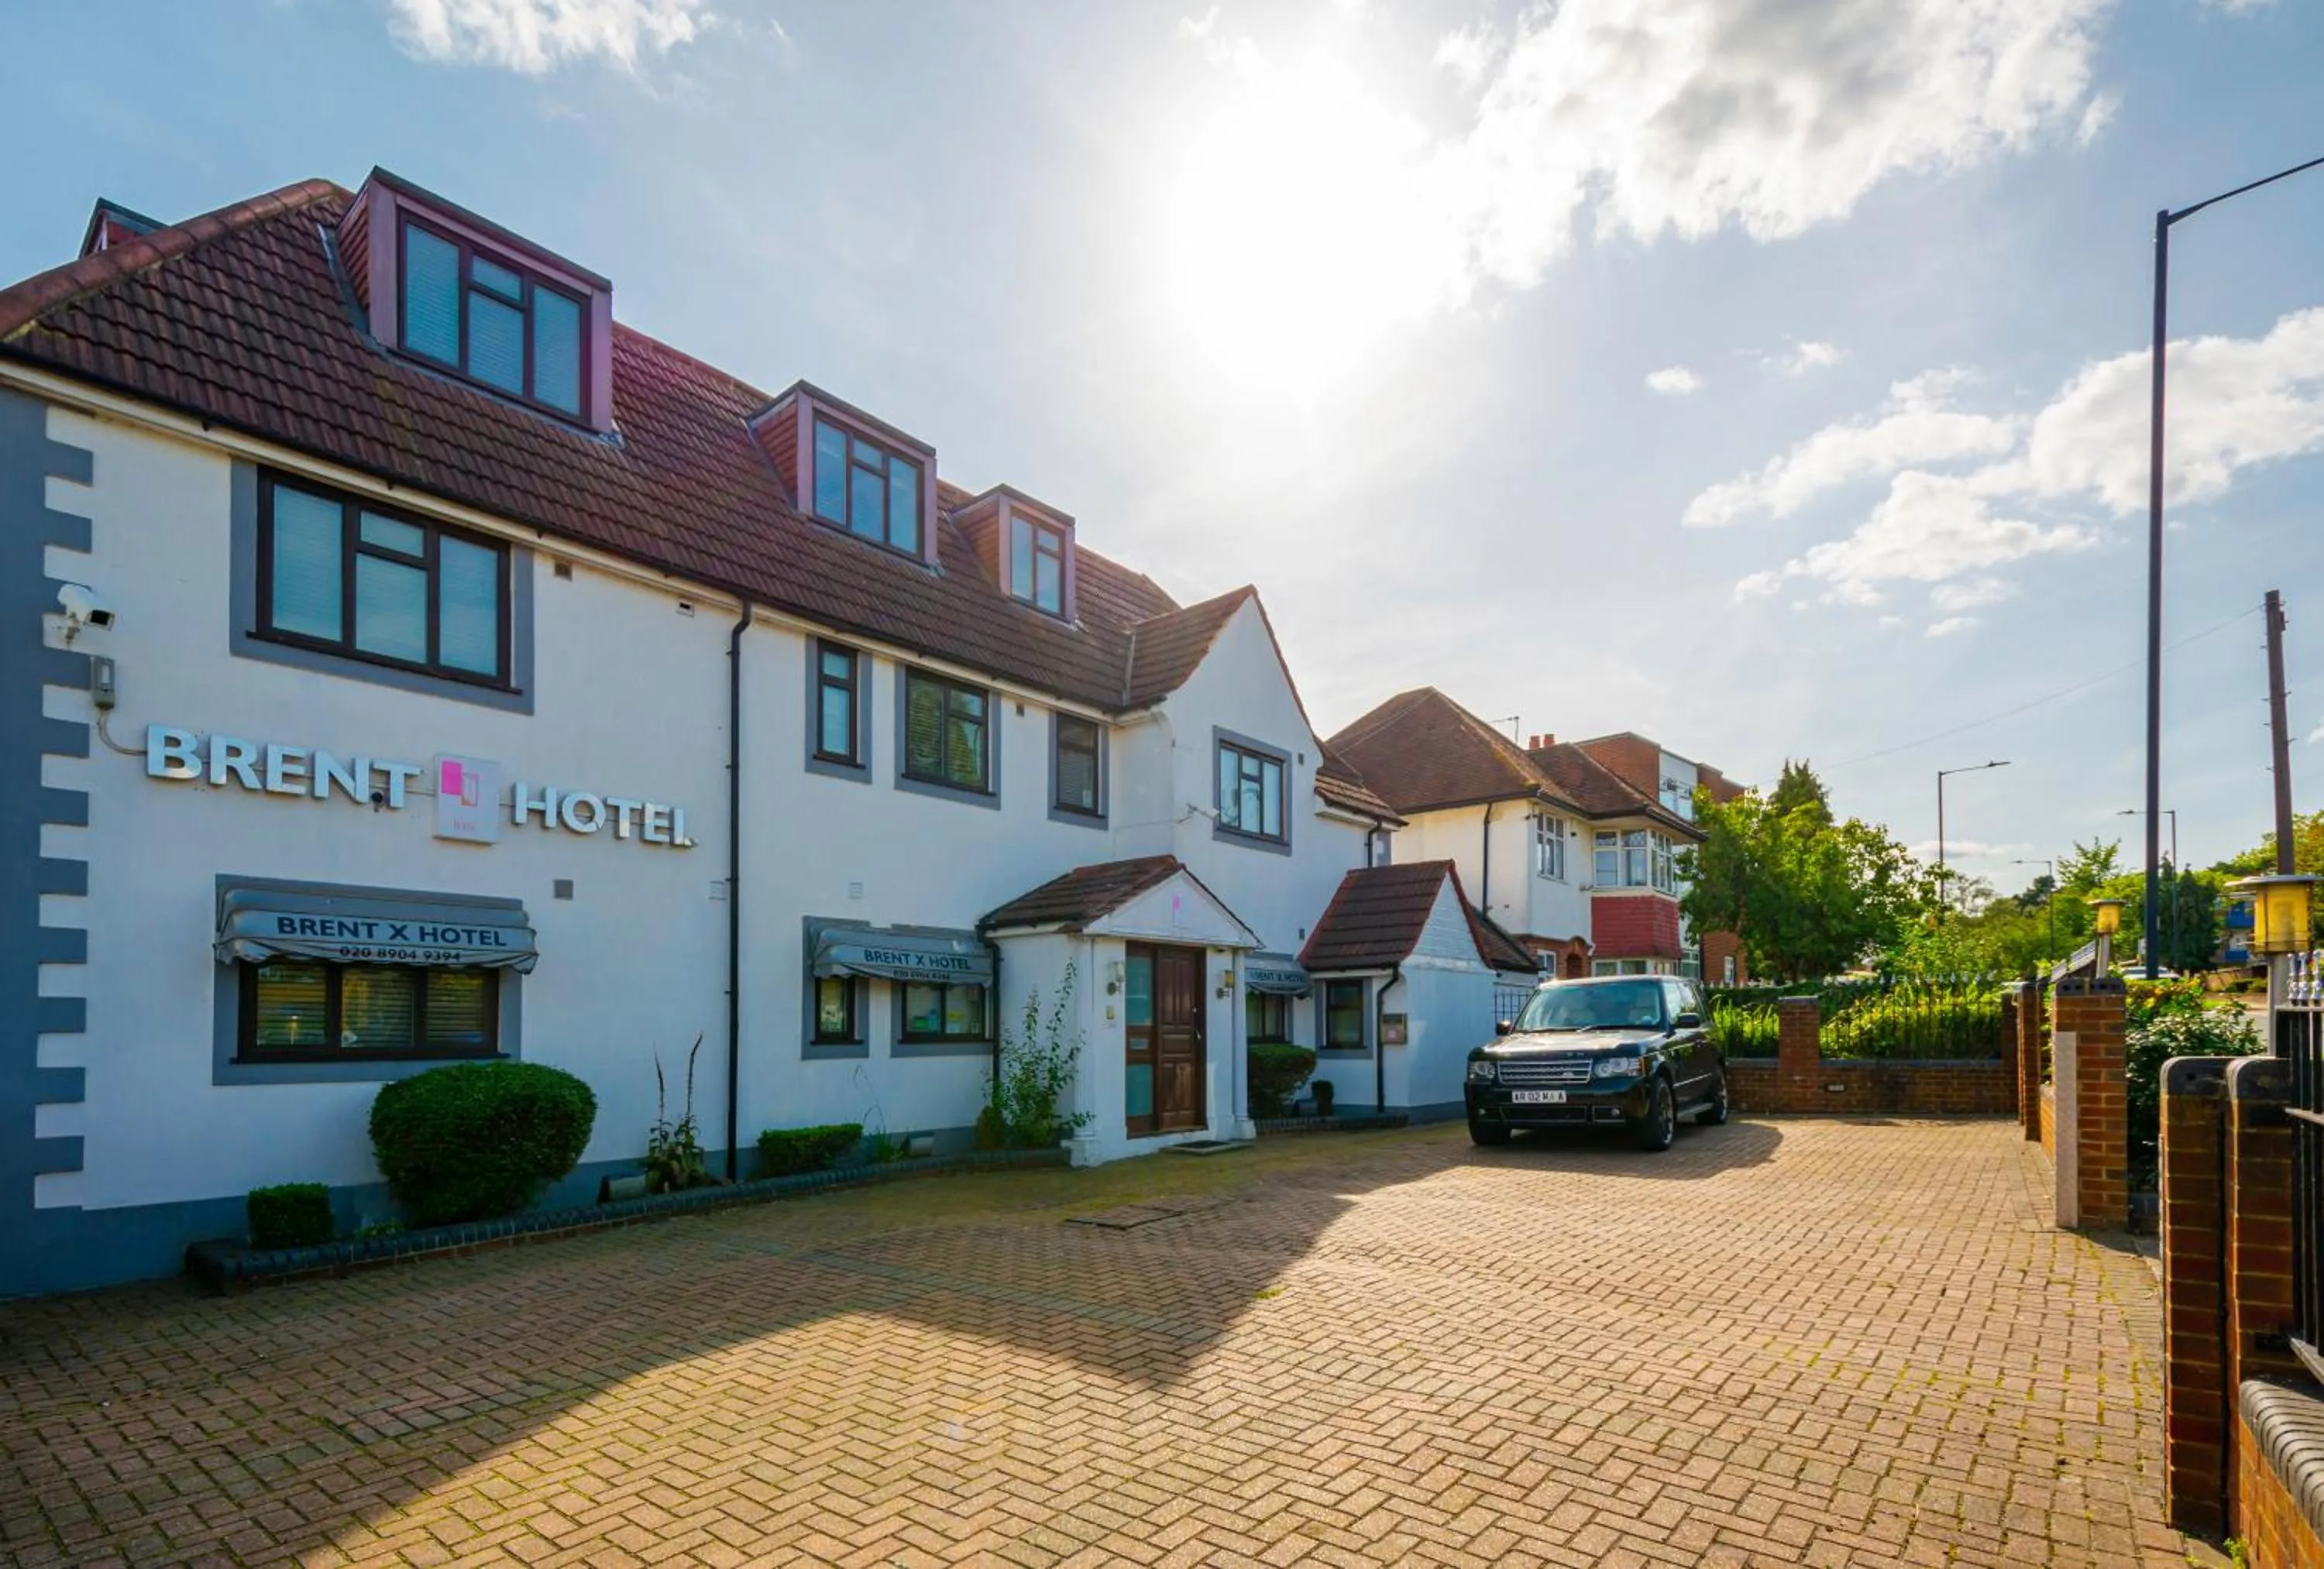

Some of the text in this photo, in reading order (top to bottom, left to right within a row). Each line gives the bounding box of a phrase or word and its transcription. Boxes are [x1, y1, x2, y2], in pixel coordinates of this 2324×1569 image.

[146, 724, 694, 847] BRENT HOTEL
[277, 916, 507, 947] BRENT X HOTEL
[339, 945, 462, 962] 020 8904 9394
[864, 949, 971, 970] BRENT X HOTEL
